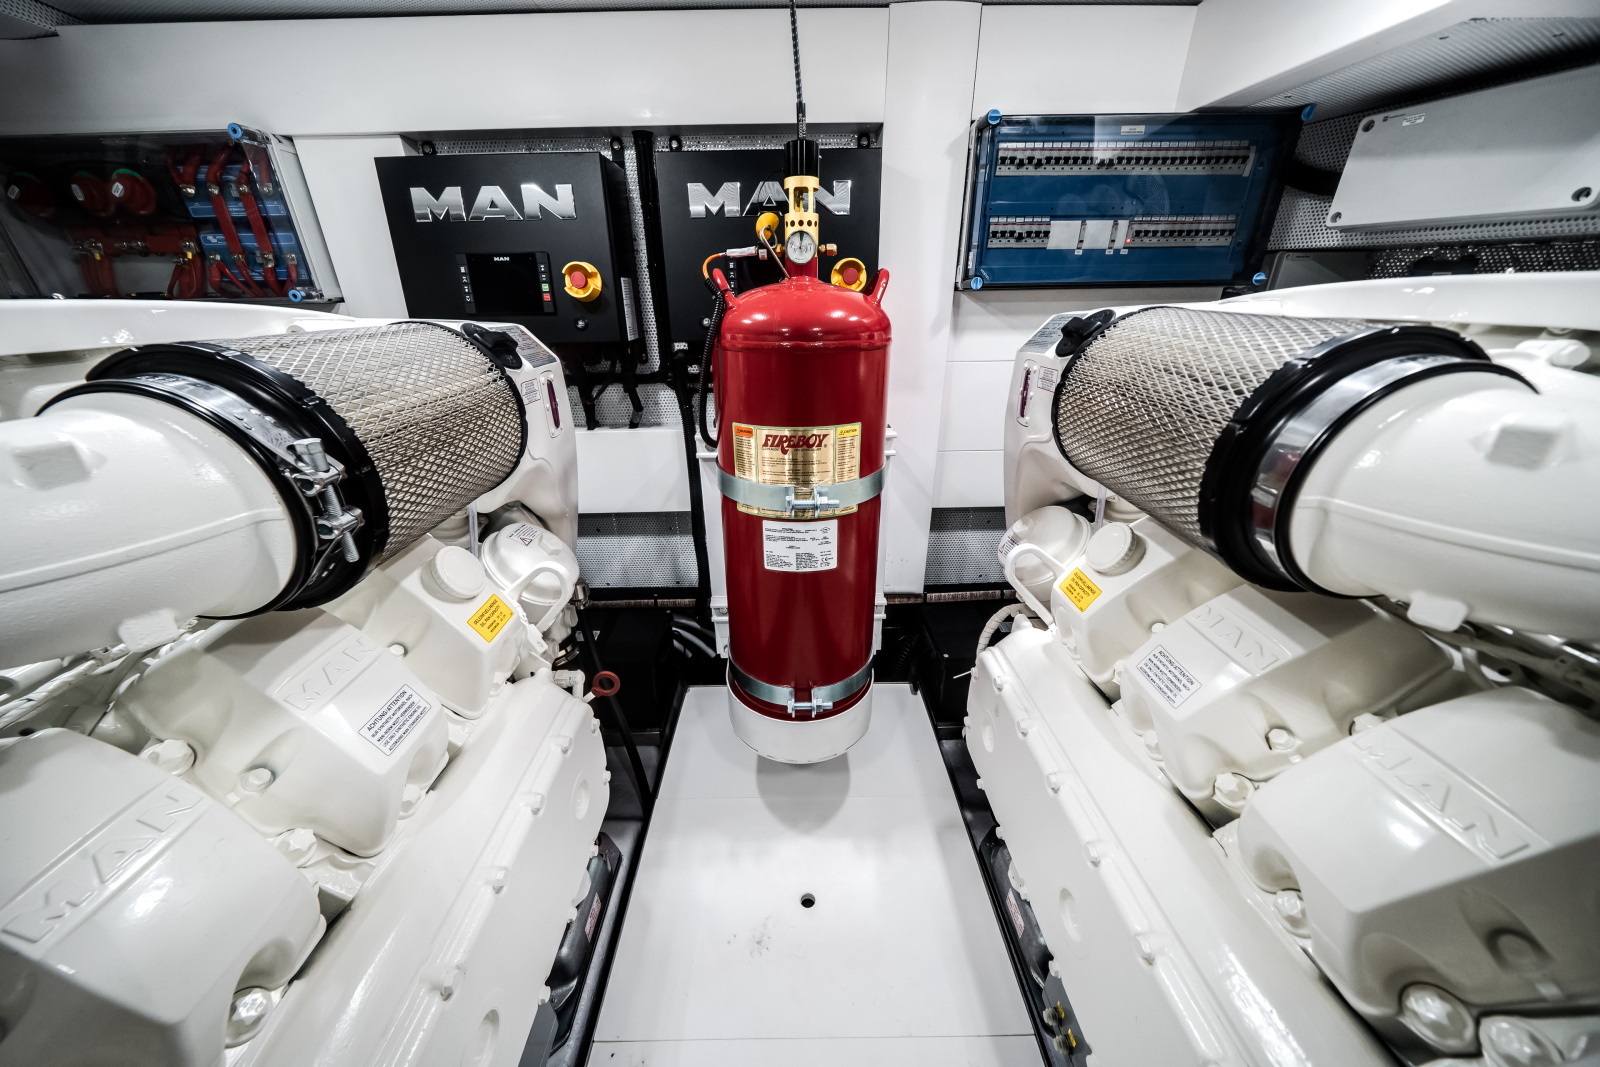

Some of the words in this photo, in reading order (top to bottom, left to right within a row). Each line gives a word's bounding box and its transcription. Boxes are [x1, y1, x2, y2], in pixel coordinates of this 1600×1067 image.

[409, 183, 577, 223] MAN
[687, 180, 851, 219] MAN
[762, 433, 830, 455] FIREBOY
[1078, 585, 1090, 597] CAPACITY
[489, 604, 500, 617] CAPACITY
[1192, 604, 1280, 671] MAN
[283, 637, 378, 712] MAN
[1157, 649, 1195, 685] ACHTUNG/ATTENTION
[365, 689, 407, 732] ACHTUNG/ATTENTION
[377, 714, 393, 731] SYNTHETIC
[394, 717, 409, 733] SYNTHETIC
[407, 708, 418, 719] ENGINE
[401, 727, 409, 735] MAN
[1352, 729, 1532, 861] MAN
[2, 785, 204, 944] MAN
